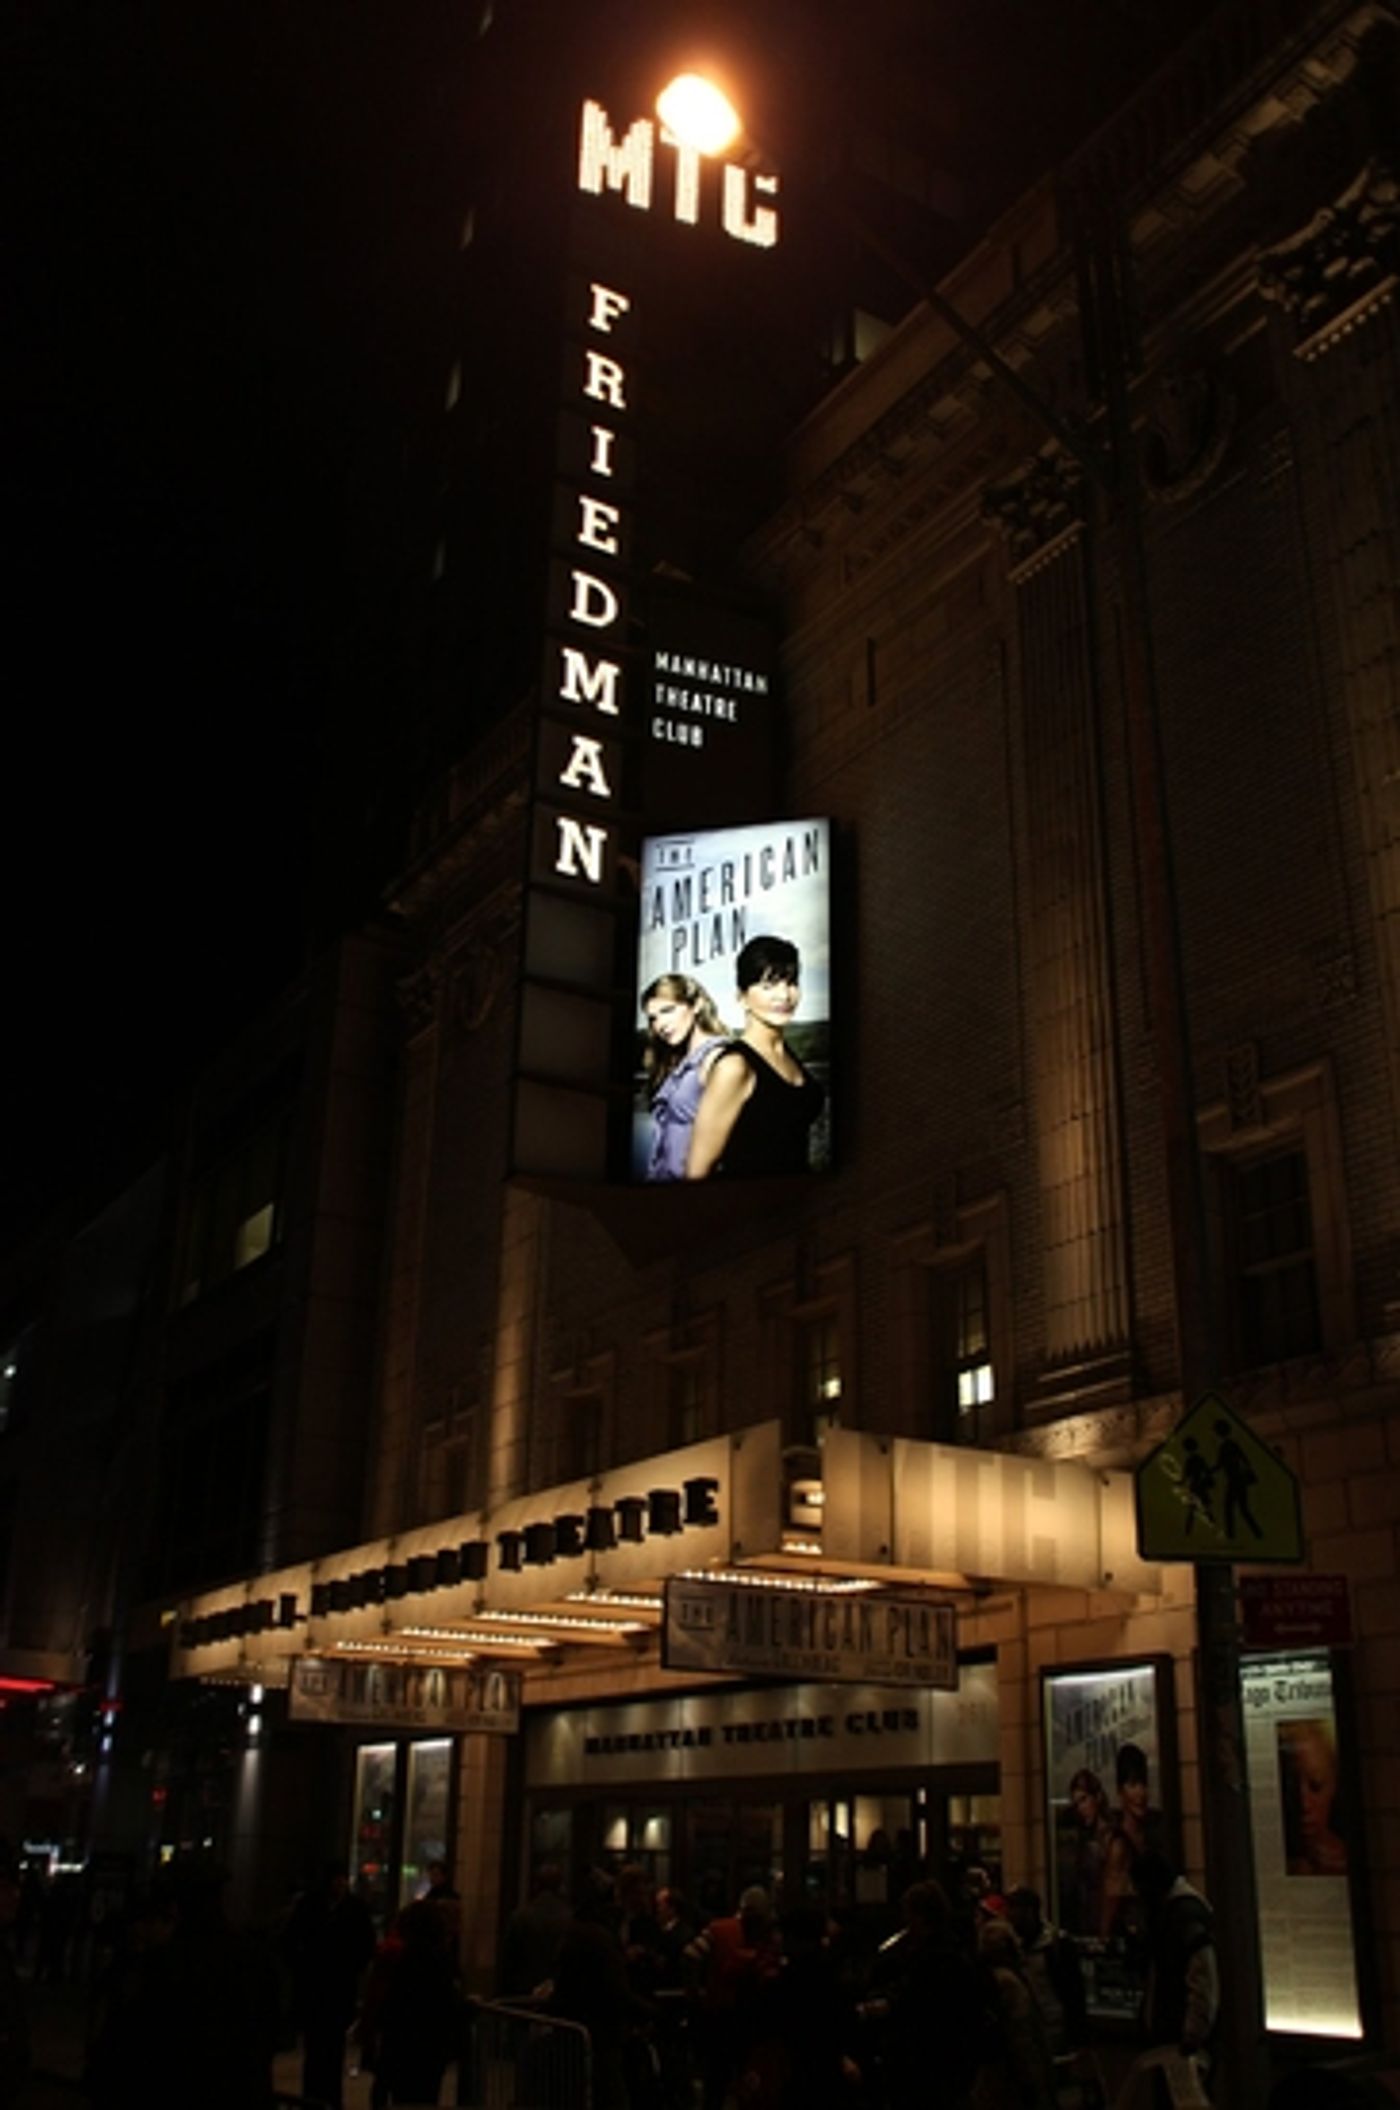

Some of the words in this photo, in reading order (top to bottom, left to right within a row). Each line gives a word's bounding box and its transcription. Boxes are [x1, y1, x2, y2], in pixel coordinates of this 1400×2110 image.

[579, 98, 778, 249] MTC
[555, 282, 630, 883] FRIEDMAN
[655, 651, 768, 694] MANHATTAN
[655, 682, 738, 722] THEATRE
[652, 717, 703, 748] CLUB
[651, 828, 819, 930] AMERICAN
[658, 847, 693, 864] THE
[671, 905, 746, 972] PLAN
[497, 1476, 720, 1574] THEATRE
[726, 1591, 872, 1653] AMERICAN
[887, 1605, 950, 1661] PLAN
[585, 1725, 712, 1754] MANHATTAN
[721, 1712, 834, 1743] THEATRE
[845, 1708, 919, 1735] CLUB
